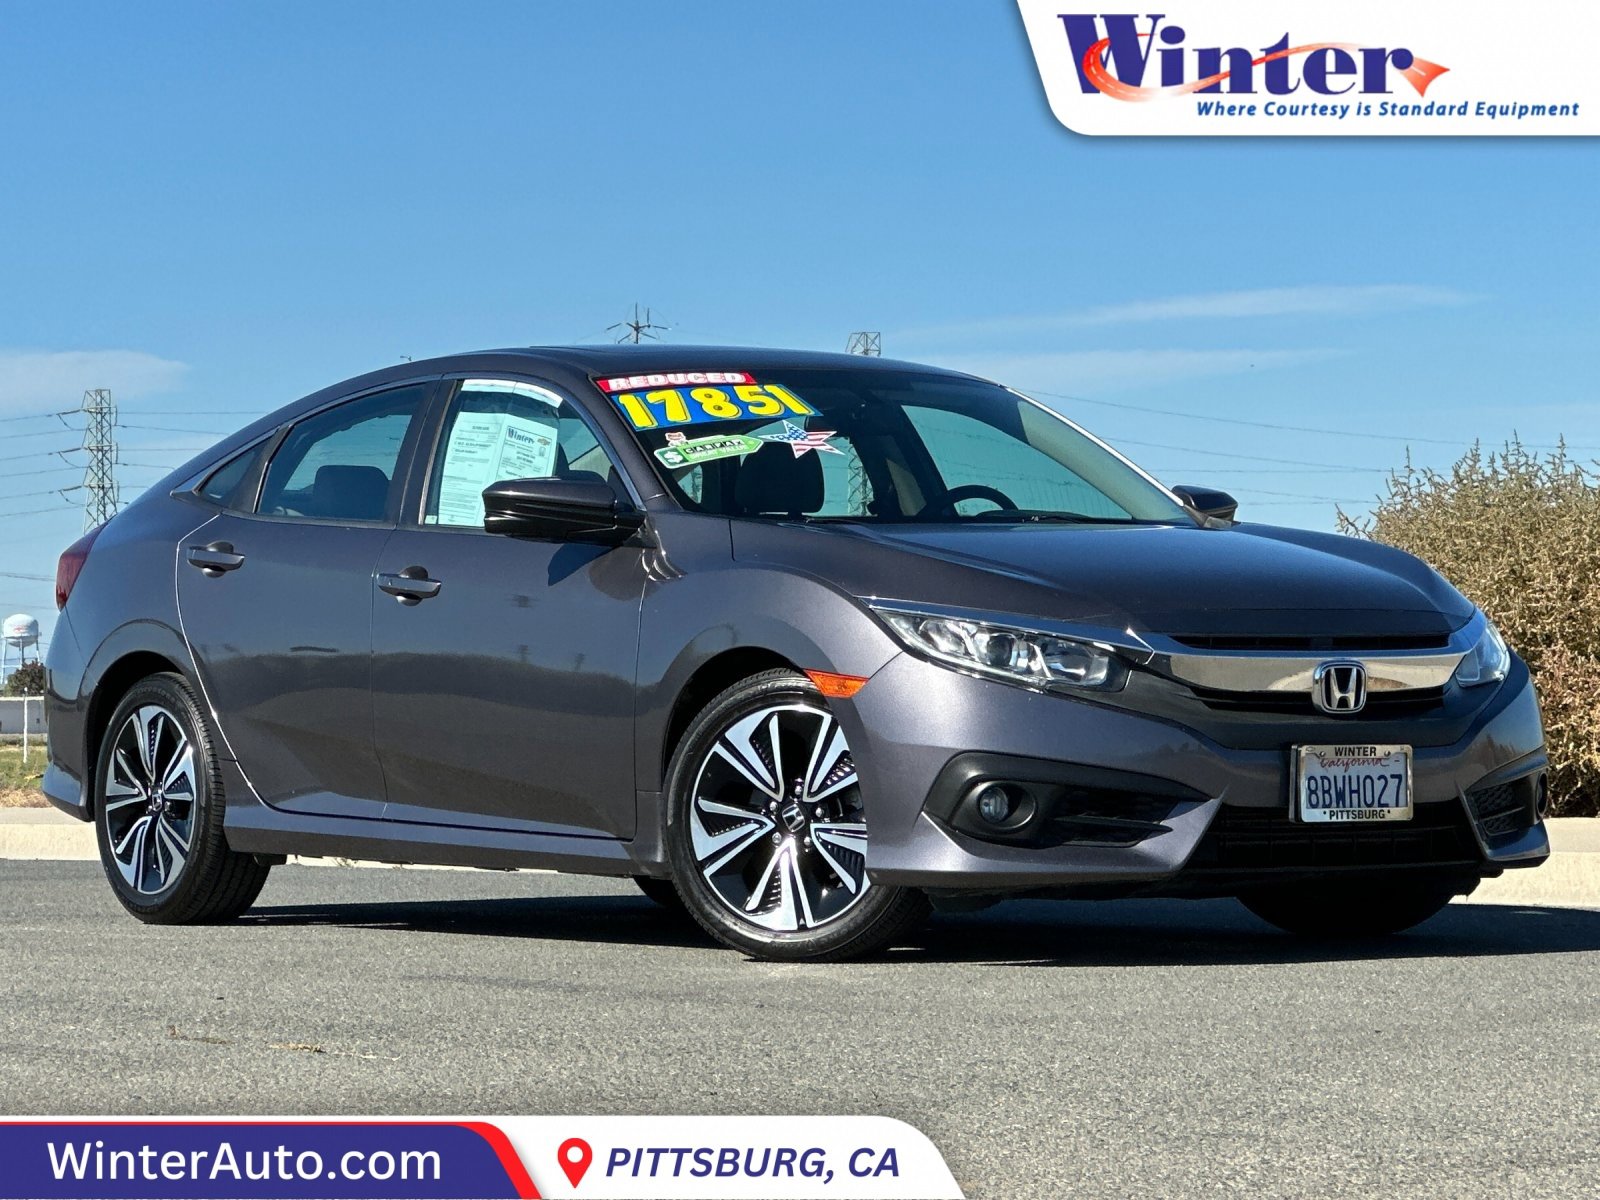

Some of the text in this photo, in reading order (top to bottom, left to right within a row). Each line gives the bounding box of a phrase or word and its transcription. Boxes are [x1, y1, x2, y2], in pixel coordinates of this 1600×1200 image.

[608, 372, 746, 390] REDUCED
[618, 383, 815, 428] 17851
[1334, 746, 1377, 757] WINTER
[1307, 773, 1403, 809] 8BWH027
[1329, 809, 1386, 821] PITTSBURG
